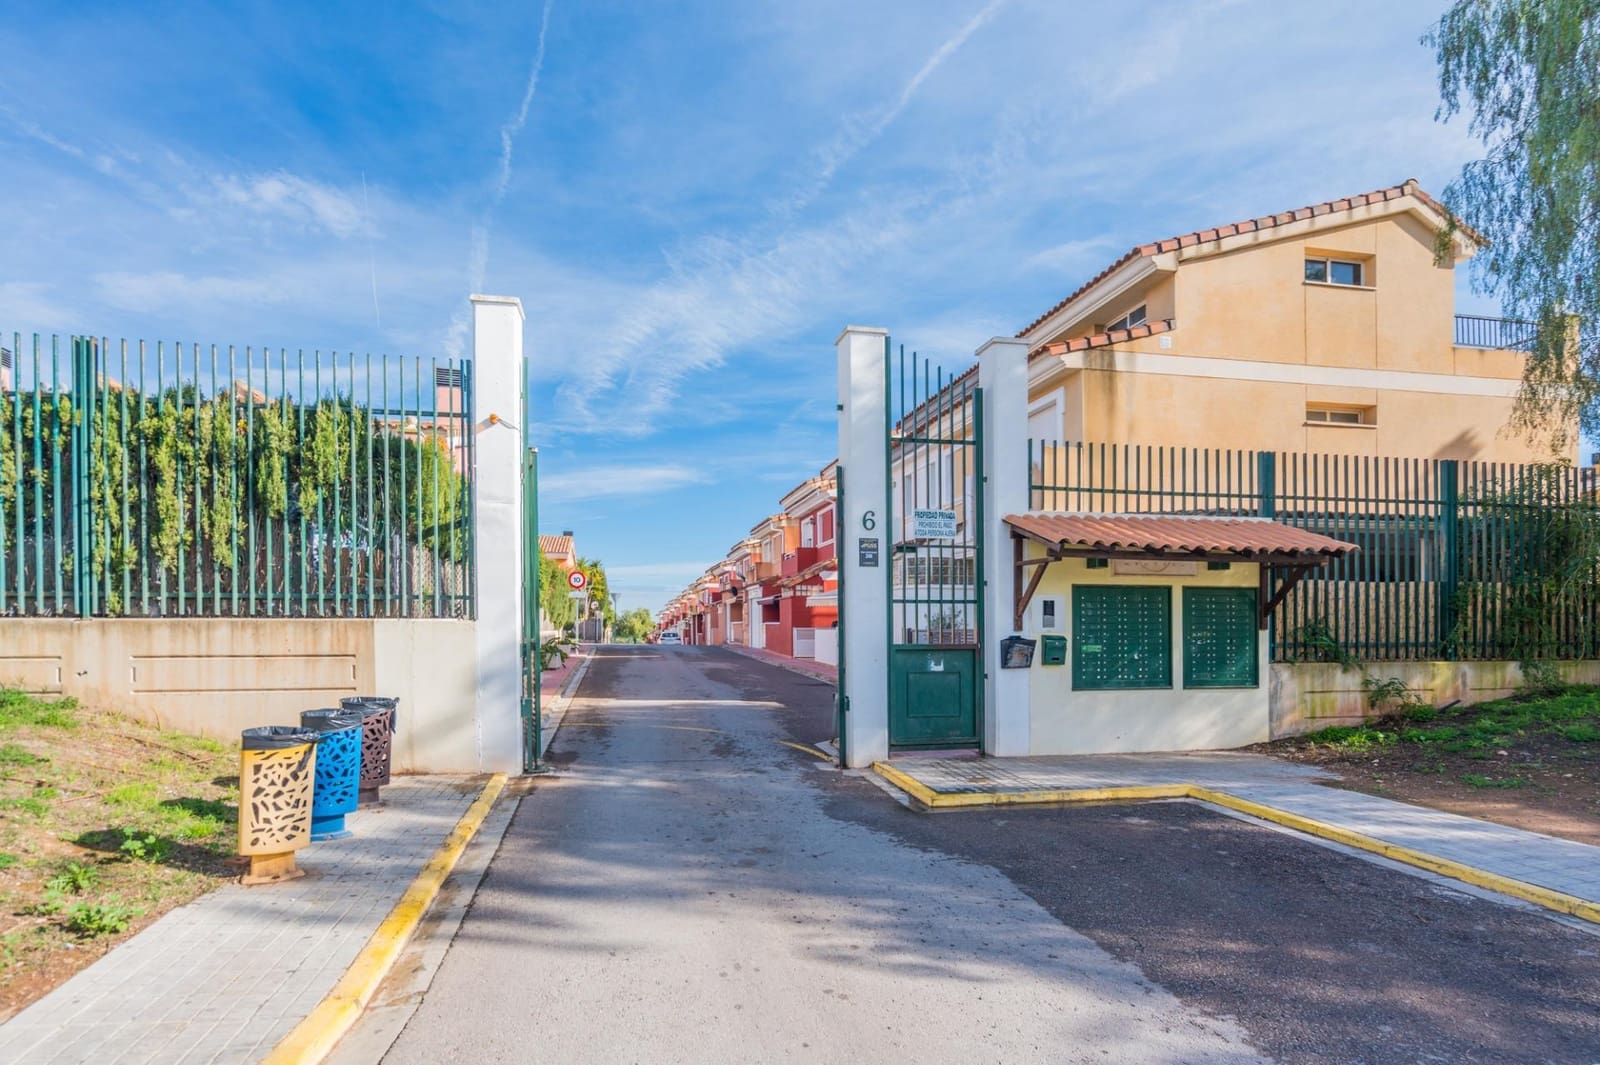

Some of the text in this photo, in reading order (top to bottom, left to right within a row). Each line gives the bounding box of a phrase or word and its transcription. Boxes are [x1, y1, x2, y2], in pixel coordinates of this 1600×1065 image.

[862, 510, 876, 531] 6
[915, 511, 955, 519] PROPIEDAD PRIVADA
